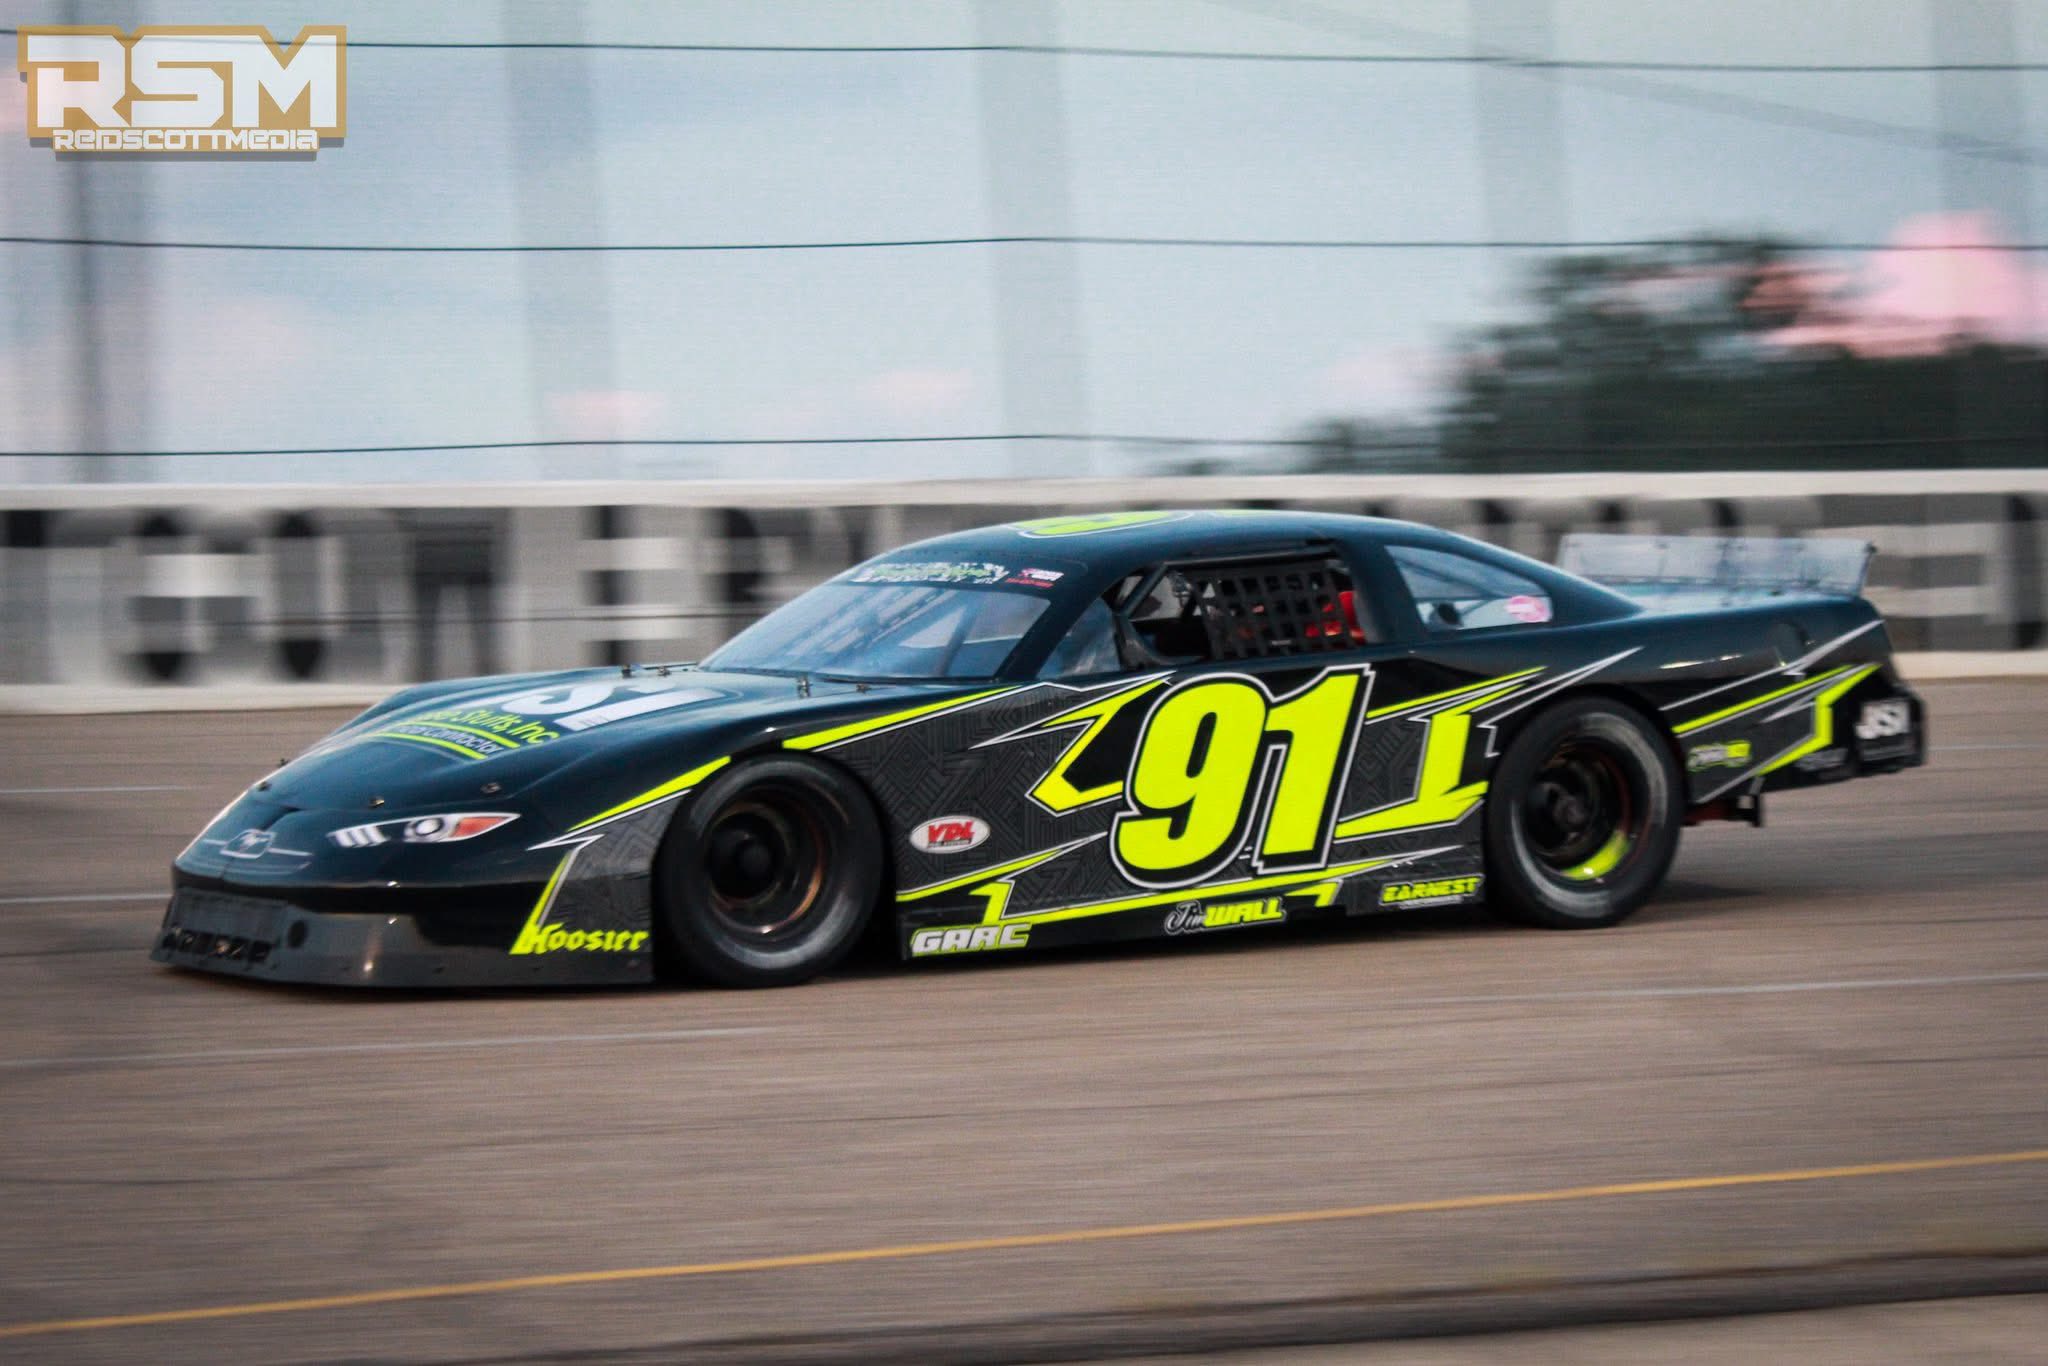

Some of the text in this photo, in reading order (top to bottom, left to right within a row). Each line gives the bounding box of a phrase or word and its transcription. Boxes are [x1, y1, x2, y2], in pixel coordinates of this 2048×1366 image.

[1110, 671, 1376, 889] 91
[1203, 897, 1284, 928] WALL
[509, 922, 650, 955] Hoosier
